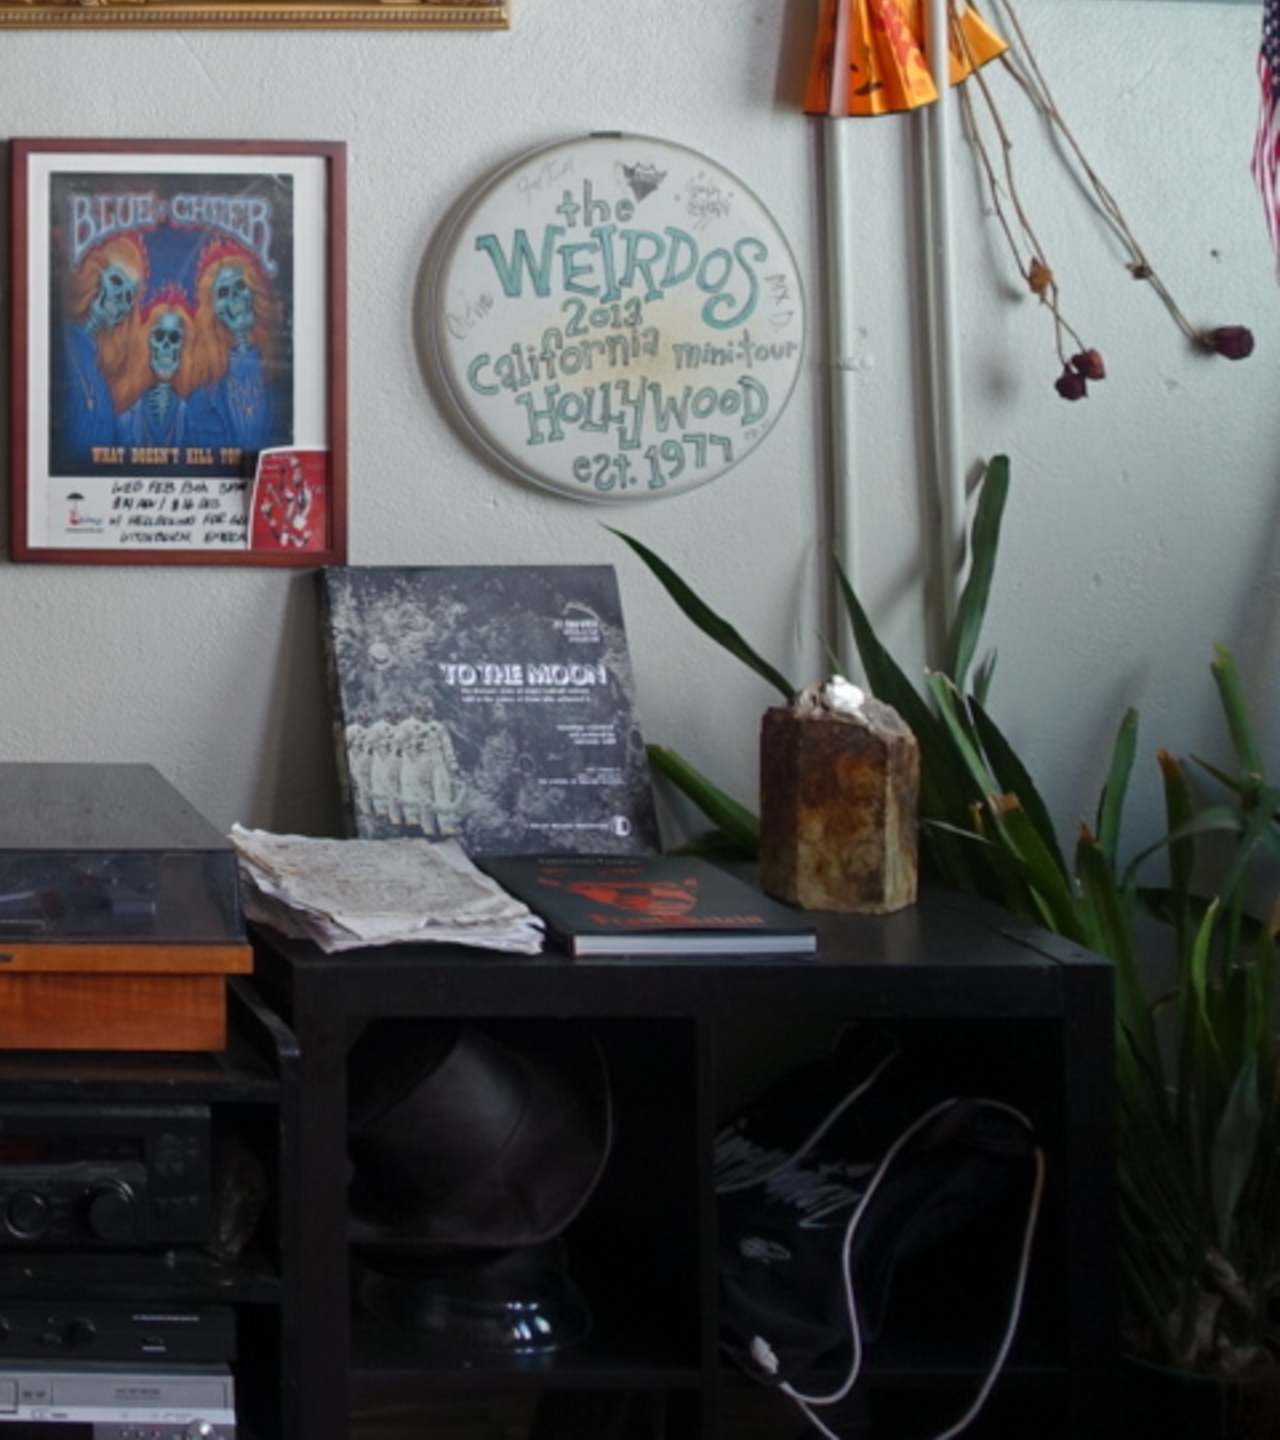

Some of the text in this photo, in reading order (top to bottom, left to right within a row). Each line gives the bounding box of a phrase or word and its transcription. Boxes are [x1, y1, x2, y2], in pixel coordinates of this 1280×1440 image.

[556, 178, 635, 228] the
[70, 190, 279, 280] BLUE CHEER
[474, 223, 769, 330] WEIRDOS
[561, 296, 644, 338] 2013
[466, 327, 660, 397] California
[92, 447, 124, 464] WHAT
[186, 447, 214, 464] KILL
[644, 432, 734, 491] 1977
[148, 480, 175, 495] FEB
[441, 663, 609, 686] TO THE MOON
